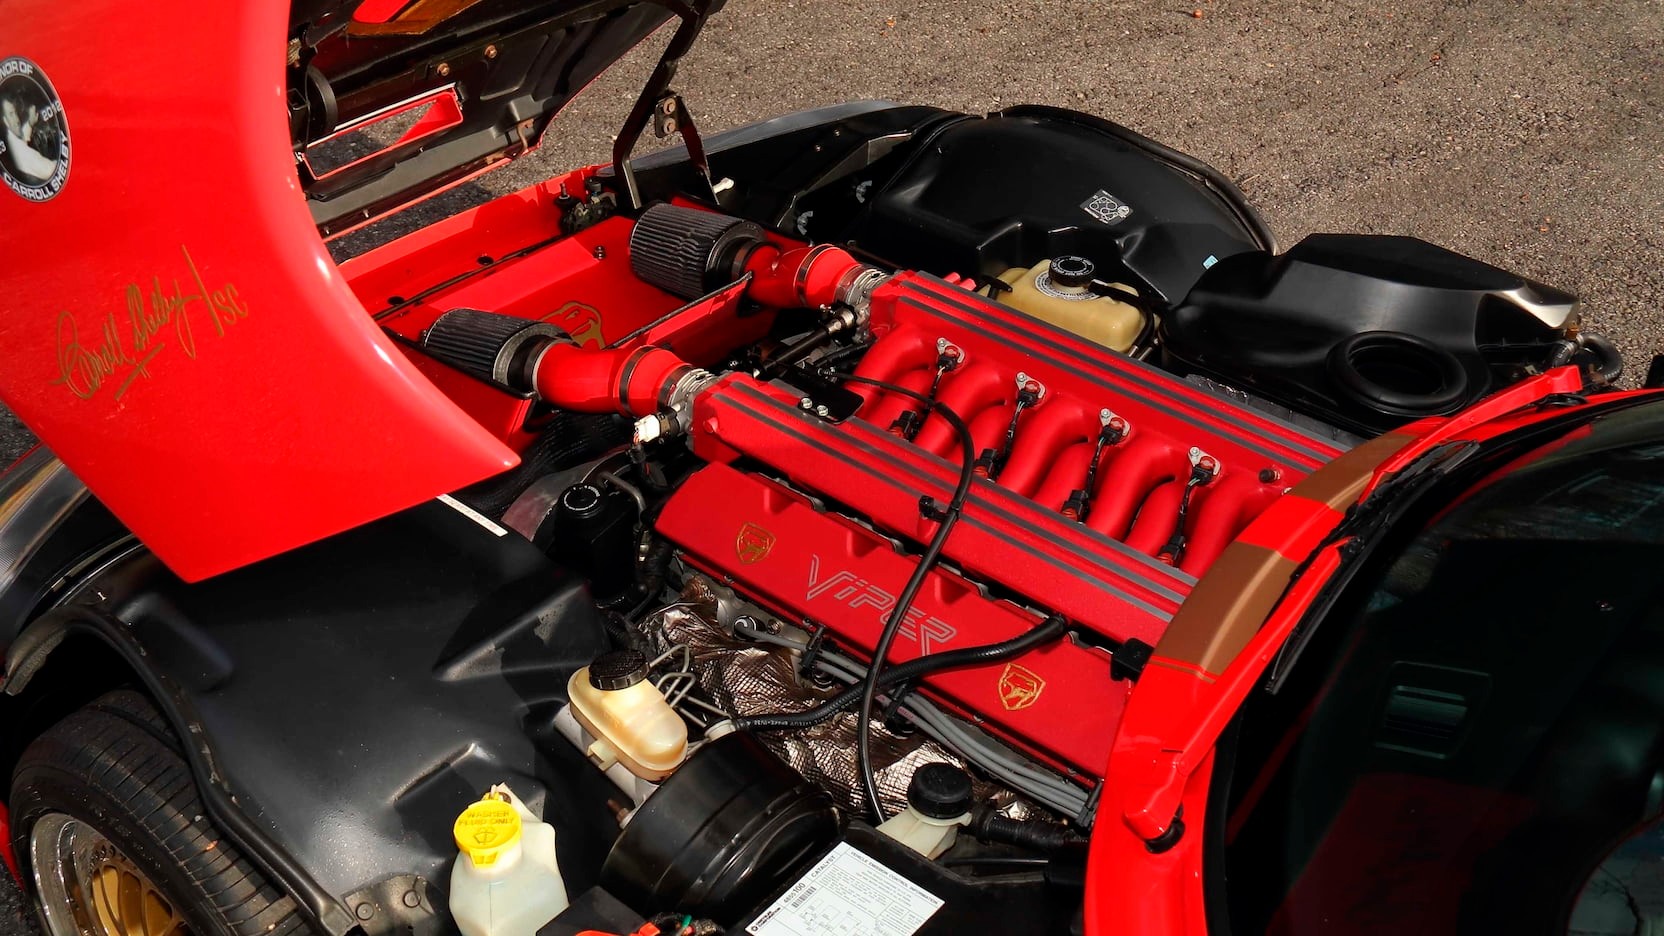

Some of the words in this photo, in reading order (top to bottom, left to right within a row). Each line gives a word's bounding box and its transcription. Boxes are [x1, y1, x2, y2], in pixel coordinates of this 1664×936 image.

[18, 60, 33, 75] OF
[41, 101, 62, 122] 2012
[3, 172, 53, 200] CARROLL
[53, 130, 69, 191] SHELBY
[458, 818, 487, 826] FLUID
[490, 817, 515, 825] ONLY
[466, 810, 510, 818] WASHER
[811, 855, 837, 878] CATALYST
[850, 851, 868, 864] VEHICLE
[868, 861, 889, 876] EMISSION
[888, 874, 909, 888] CONTROL
[909, 885, 939, 905] INFORMATION
